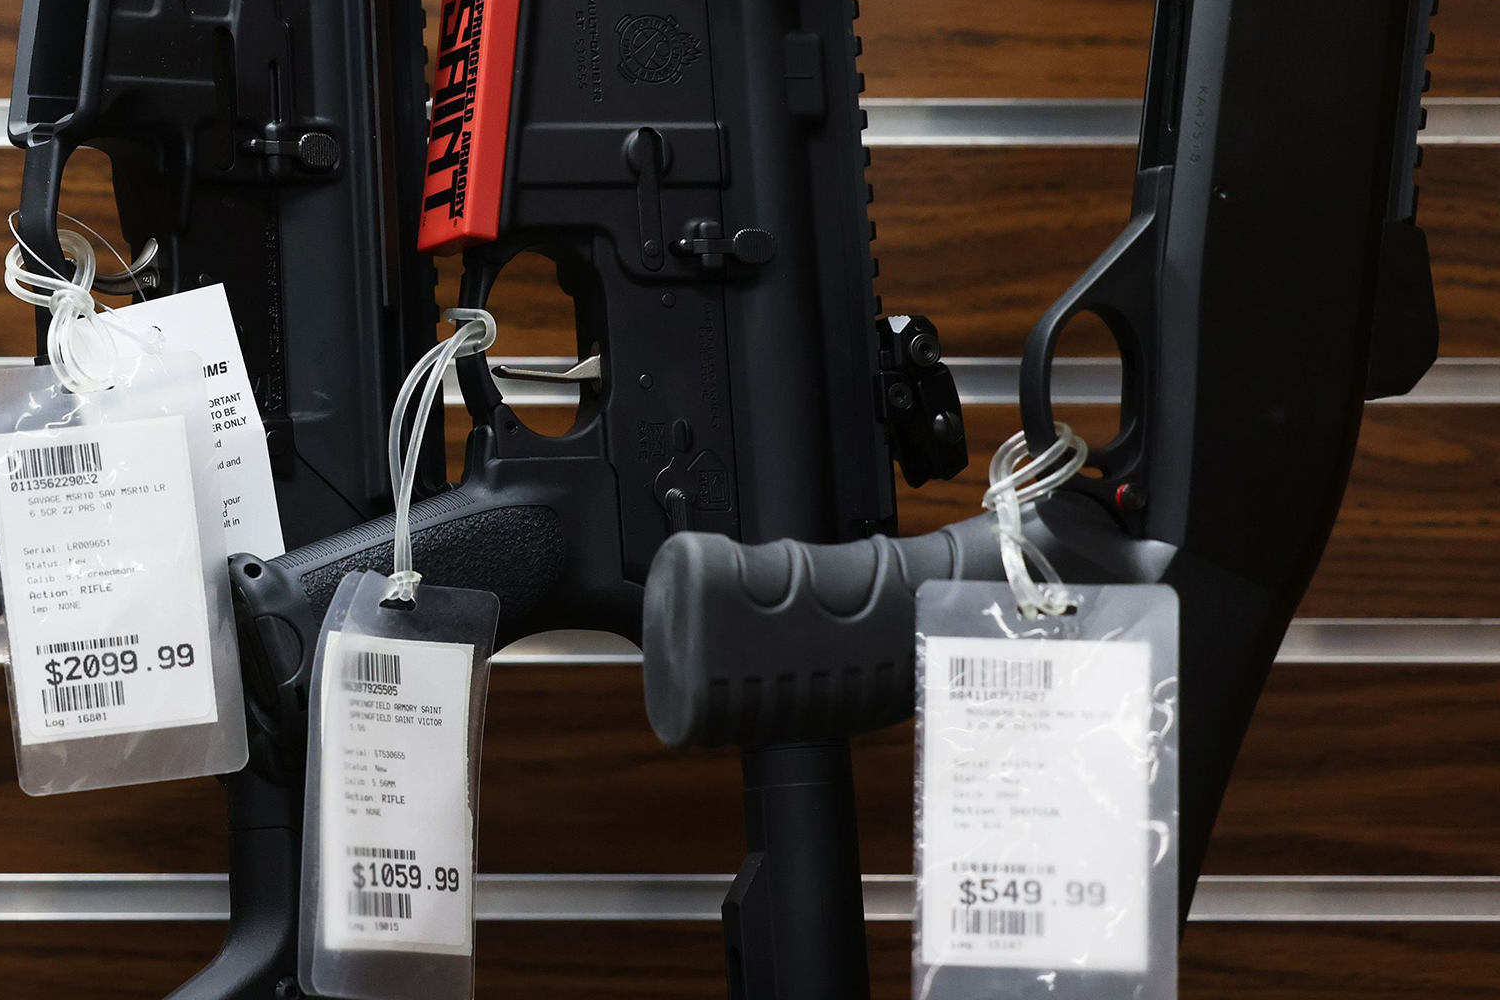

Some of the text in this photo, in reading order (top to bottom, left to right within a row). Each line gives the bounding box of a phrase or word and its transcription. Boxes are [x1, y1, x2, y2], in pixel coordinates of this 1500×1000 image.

[452, 130, 473, 220] ARMORY
[202, 361, 228, 378] MS
[223, 406, 237, 417] BE
[223, 415, 247, 430] ONLY
[225, 456, 241, 468] and
[28, 483, 166, 506] SAVAGE MSR10 SAV MSR10 LR
[222, 495, 241, 509] your
[62, 506, 74, 515] 22
[78, 503, 96, 513] PRS
[232, 517, 241, 526] in
[66, 538, 111, 551] LR009651
[29, 583, 113, 600] Action: RIFLE
[58, 601, 81, 611] NONE
[44, 642, 196, 686] $2099.99
[393, 703, 418, 713] ARMORY
[420, 705, 442, 715] SAINT
[77, 712, 108, 724] 16801
[394, 715, 415, 725] SAINT
[417, 717, 443, 727] VICTOR
[381, 794, 406, 805] RIFLE
[352, 861, 460, 893] $1059.99
[959, 877, 1107, 908] $549.99
